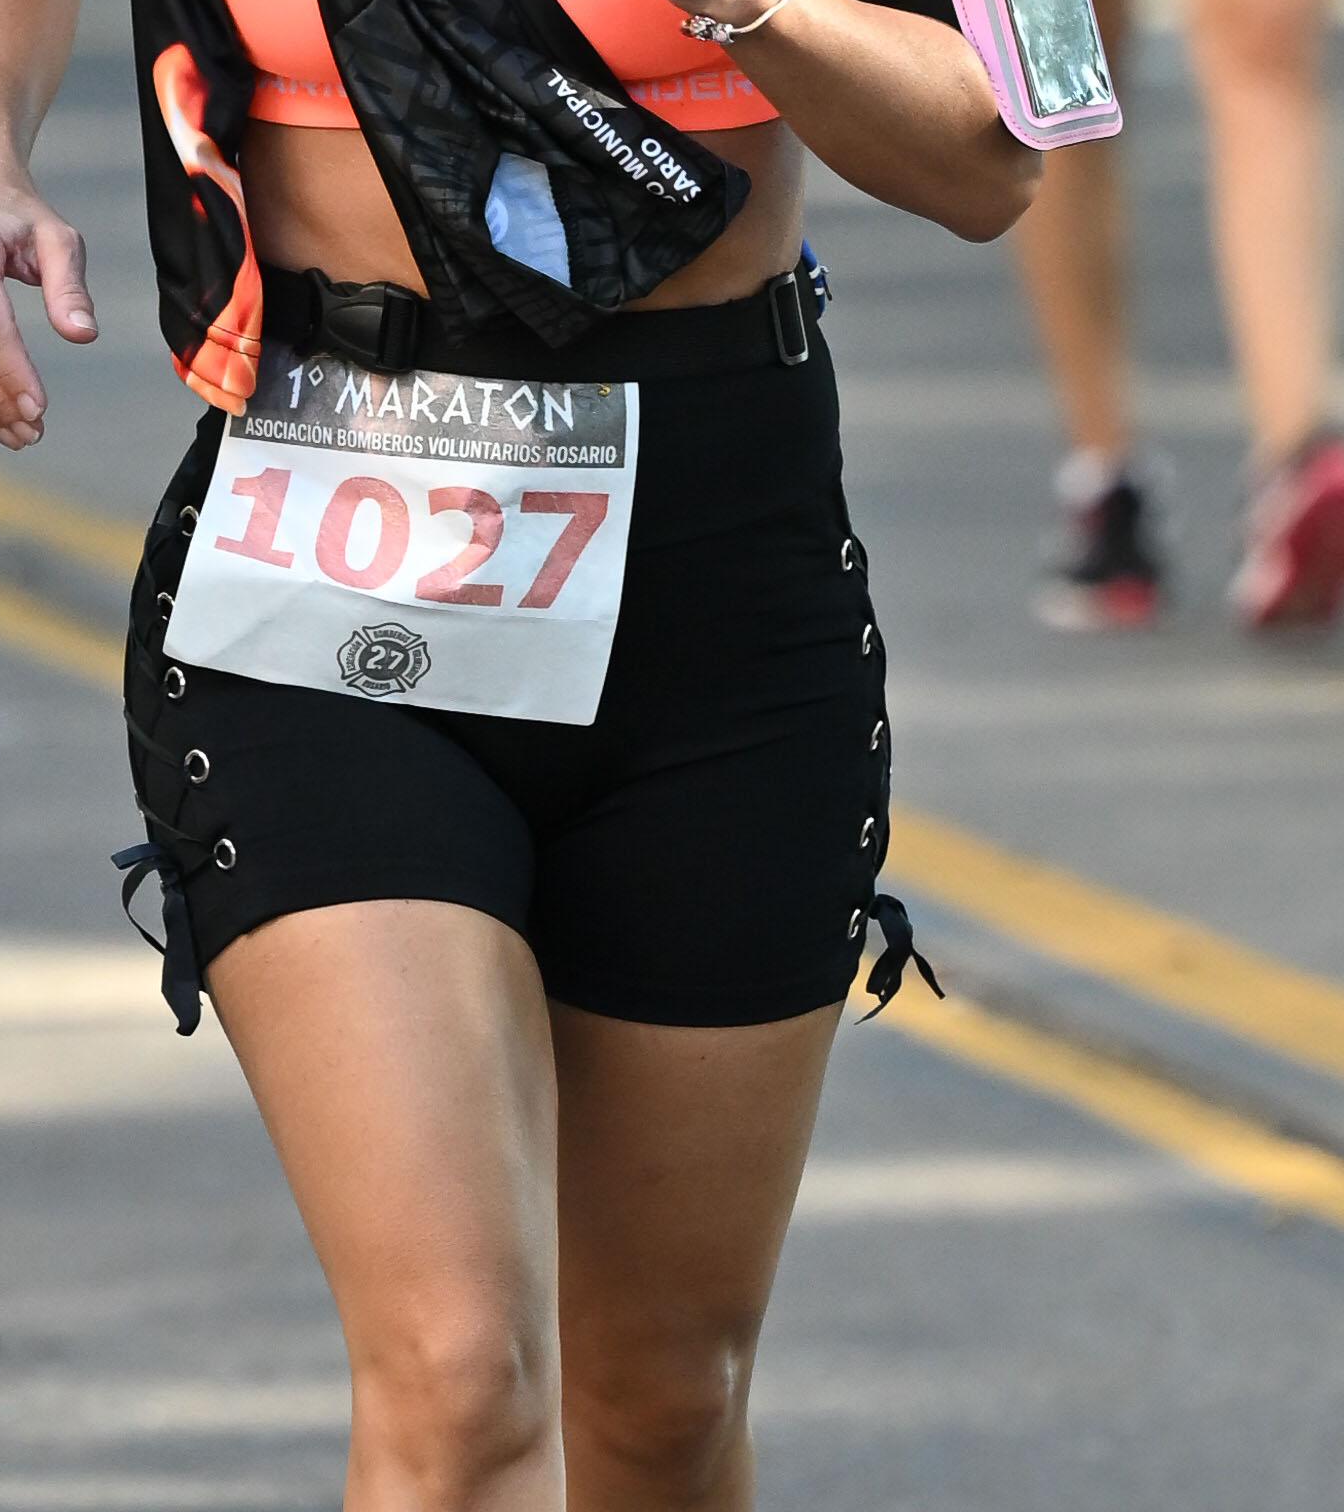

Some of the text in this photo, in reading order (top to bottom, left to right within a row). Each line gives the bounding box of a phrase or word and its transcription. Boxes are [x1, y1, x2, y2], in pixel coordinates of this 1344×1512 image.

[547, 68, 649, 181] MUNICIPAL
[334, 372, 575, 432] MARATON
[244, 415, 618, 465] ASOCIACIÓN BOMBEROS VOLUNTARIOS ROSARIO
[214, 467, 609, 609] 1027
[366, 645, 405, 670] 27
